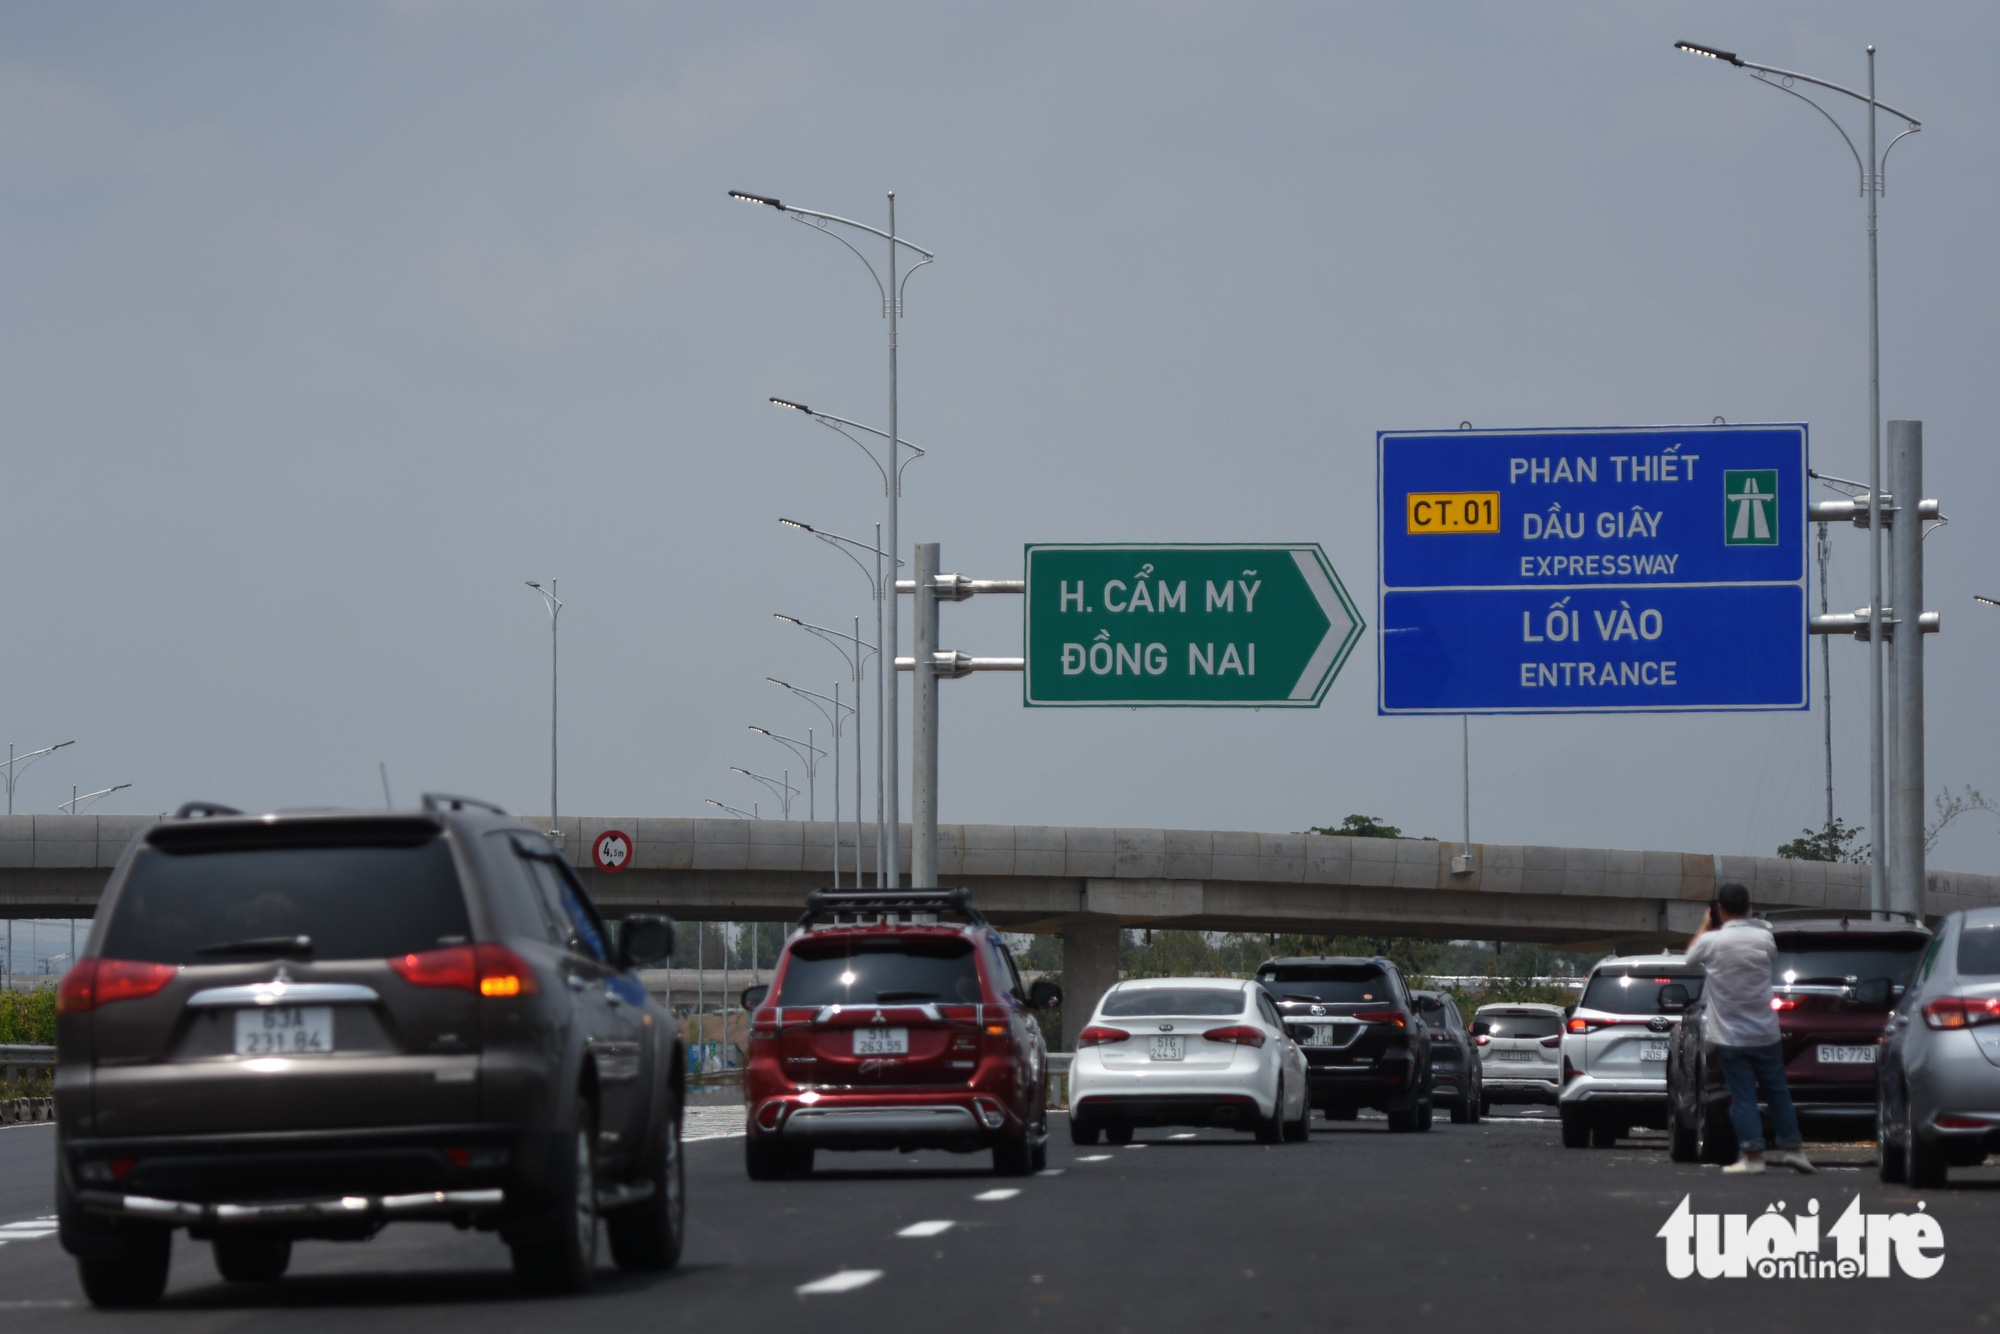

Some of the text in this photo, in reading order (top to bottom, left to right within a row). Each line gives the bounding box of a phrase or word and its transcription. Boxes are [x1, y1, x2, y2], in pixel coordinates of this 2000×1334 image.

[1510, 443, 1700, 484] PHAN THIẾT
[1413, 499, 1494, 526] CT.01
[1523, 502, 1663, 540] DẦU GIÂY
[1520, 553, 1679, 577] EXPRESSWAY
[1060, 563, 1262, 613] H. CẨM MỸ
[1523, 596, 1663, 642] LỐI VÀO
[1061, 628, 1256, 676] ĐỒNG NAI
[1520, 661, 1677, 687] ENTRANCE
[859, 1040, 902, 1053] 263.55
[1157, 1036, 1176, 1048] 51G
